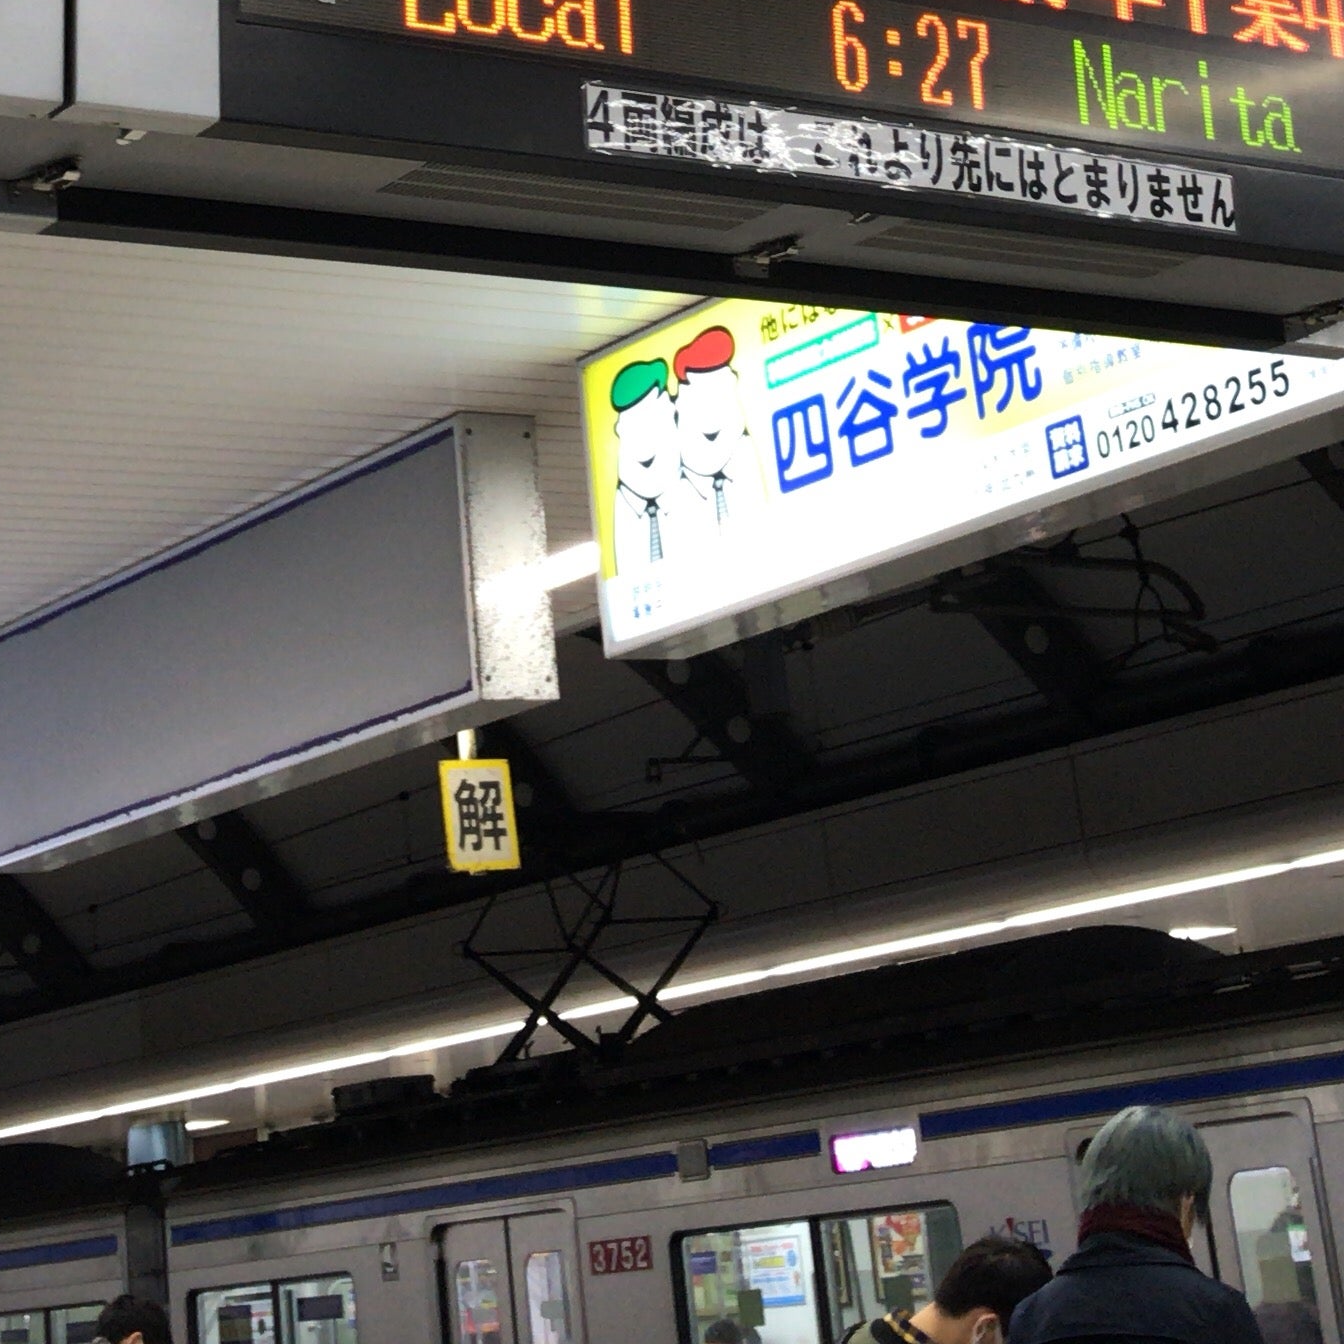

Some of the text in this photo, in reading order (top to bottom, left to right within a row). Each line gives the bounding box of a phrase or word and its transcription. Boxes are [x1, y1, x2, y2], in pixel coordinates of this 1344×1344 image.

[830, 0, 990, 110] 6:27
[1072, 39, 1303, 153] Narita
[771, 322, 1043, 494] 四谷学院
[454, 778, 508, 852] 解
[592, 1237, 650, 1273] 3752
